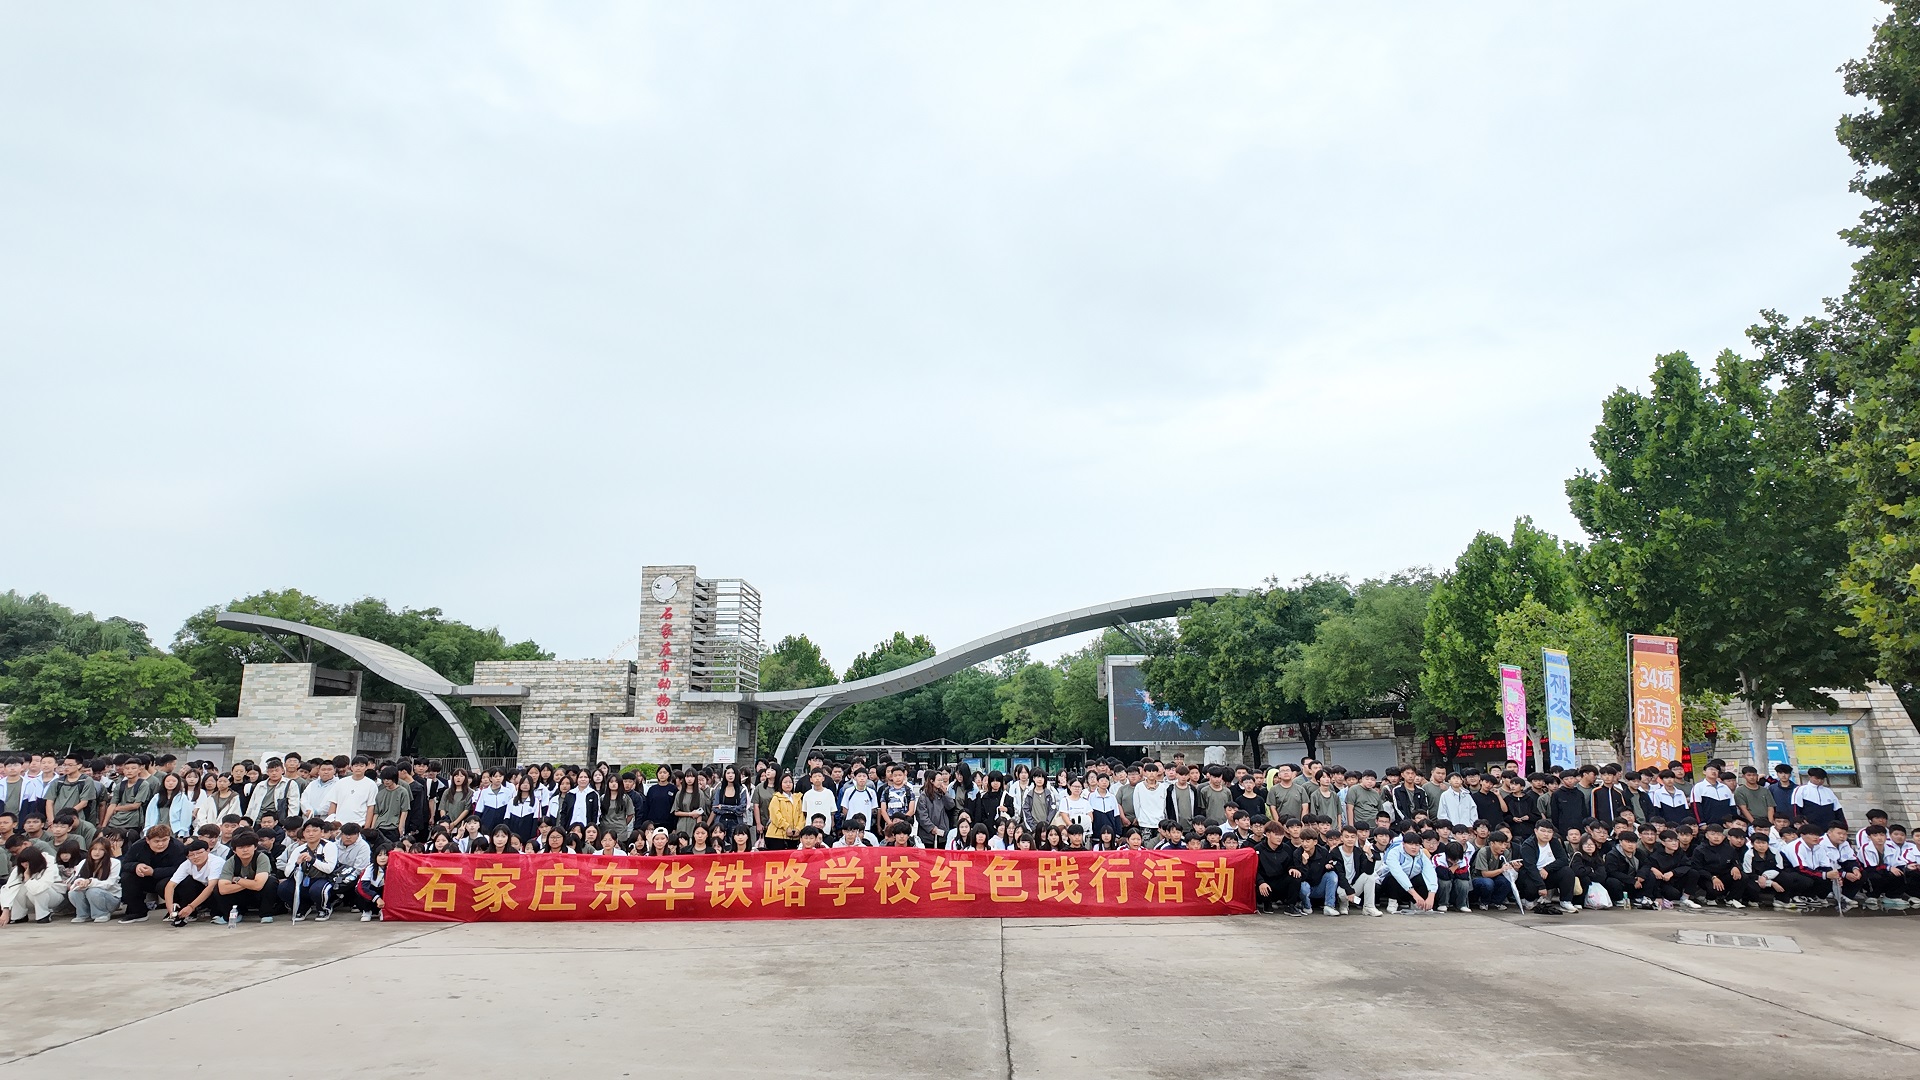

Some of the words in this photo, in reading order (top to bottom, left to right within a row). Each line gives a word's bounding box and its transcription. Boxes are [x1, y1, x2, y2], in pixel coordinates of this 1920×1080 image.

[656, 606, 673, 724] 石家庄市动物园
[1639, 666, 1675, 692] 34项
[1638, 699, 1670, 726] 游乐
[685, 725, 703, 733] ZOO
[414, 854, 1237, 913] 石家庄东华铁路学校红色践行活动
